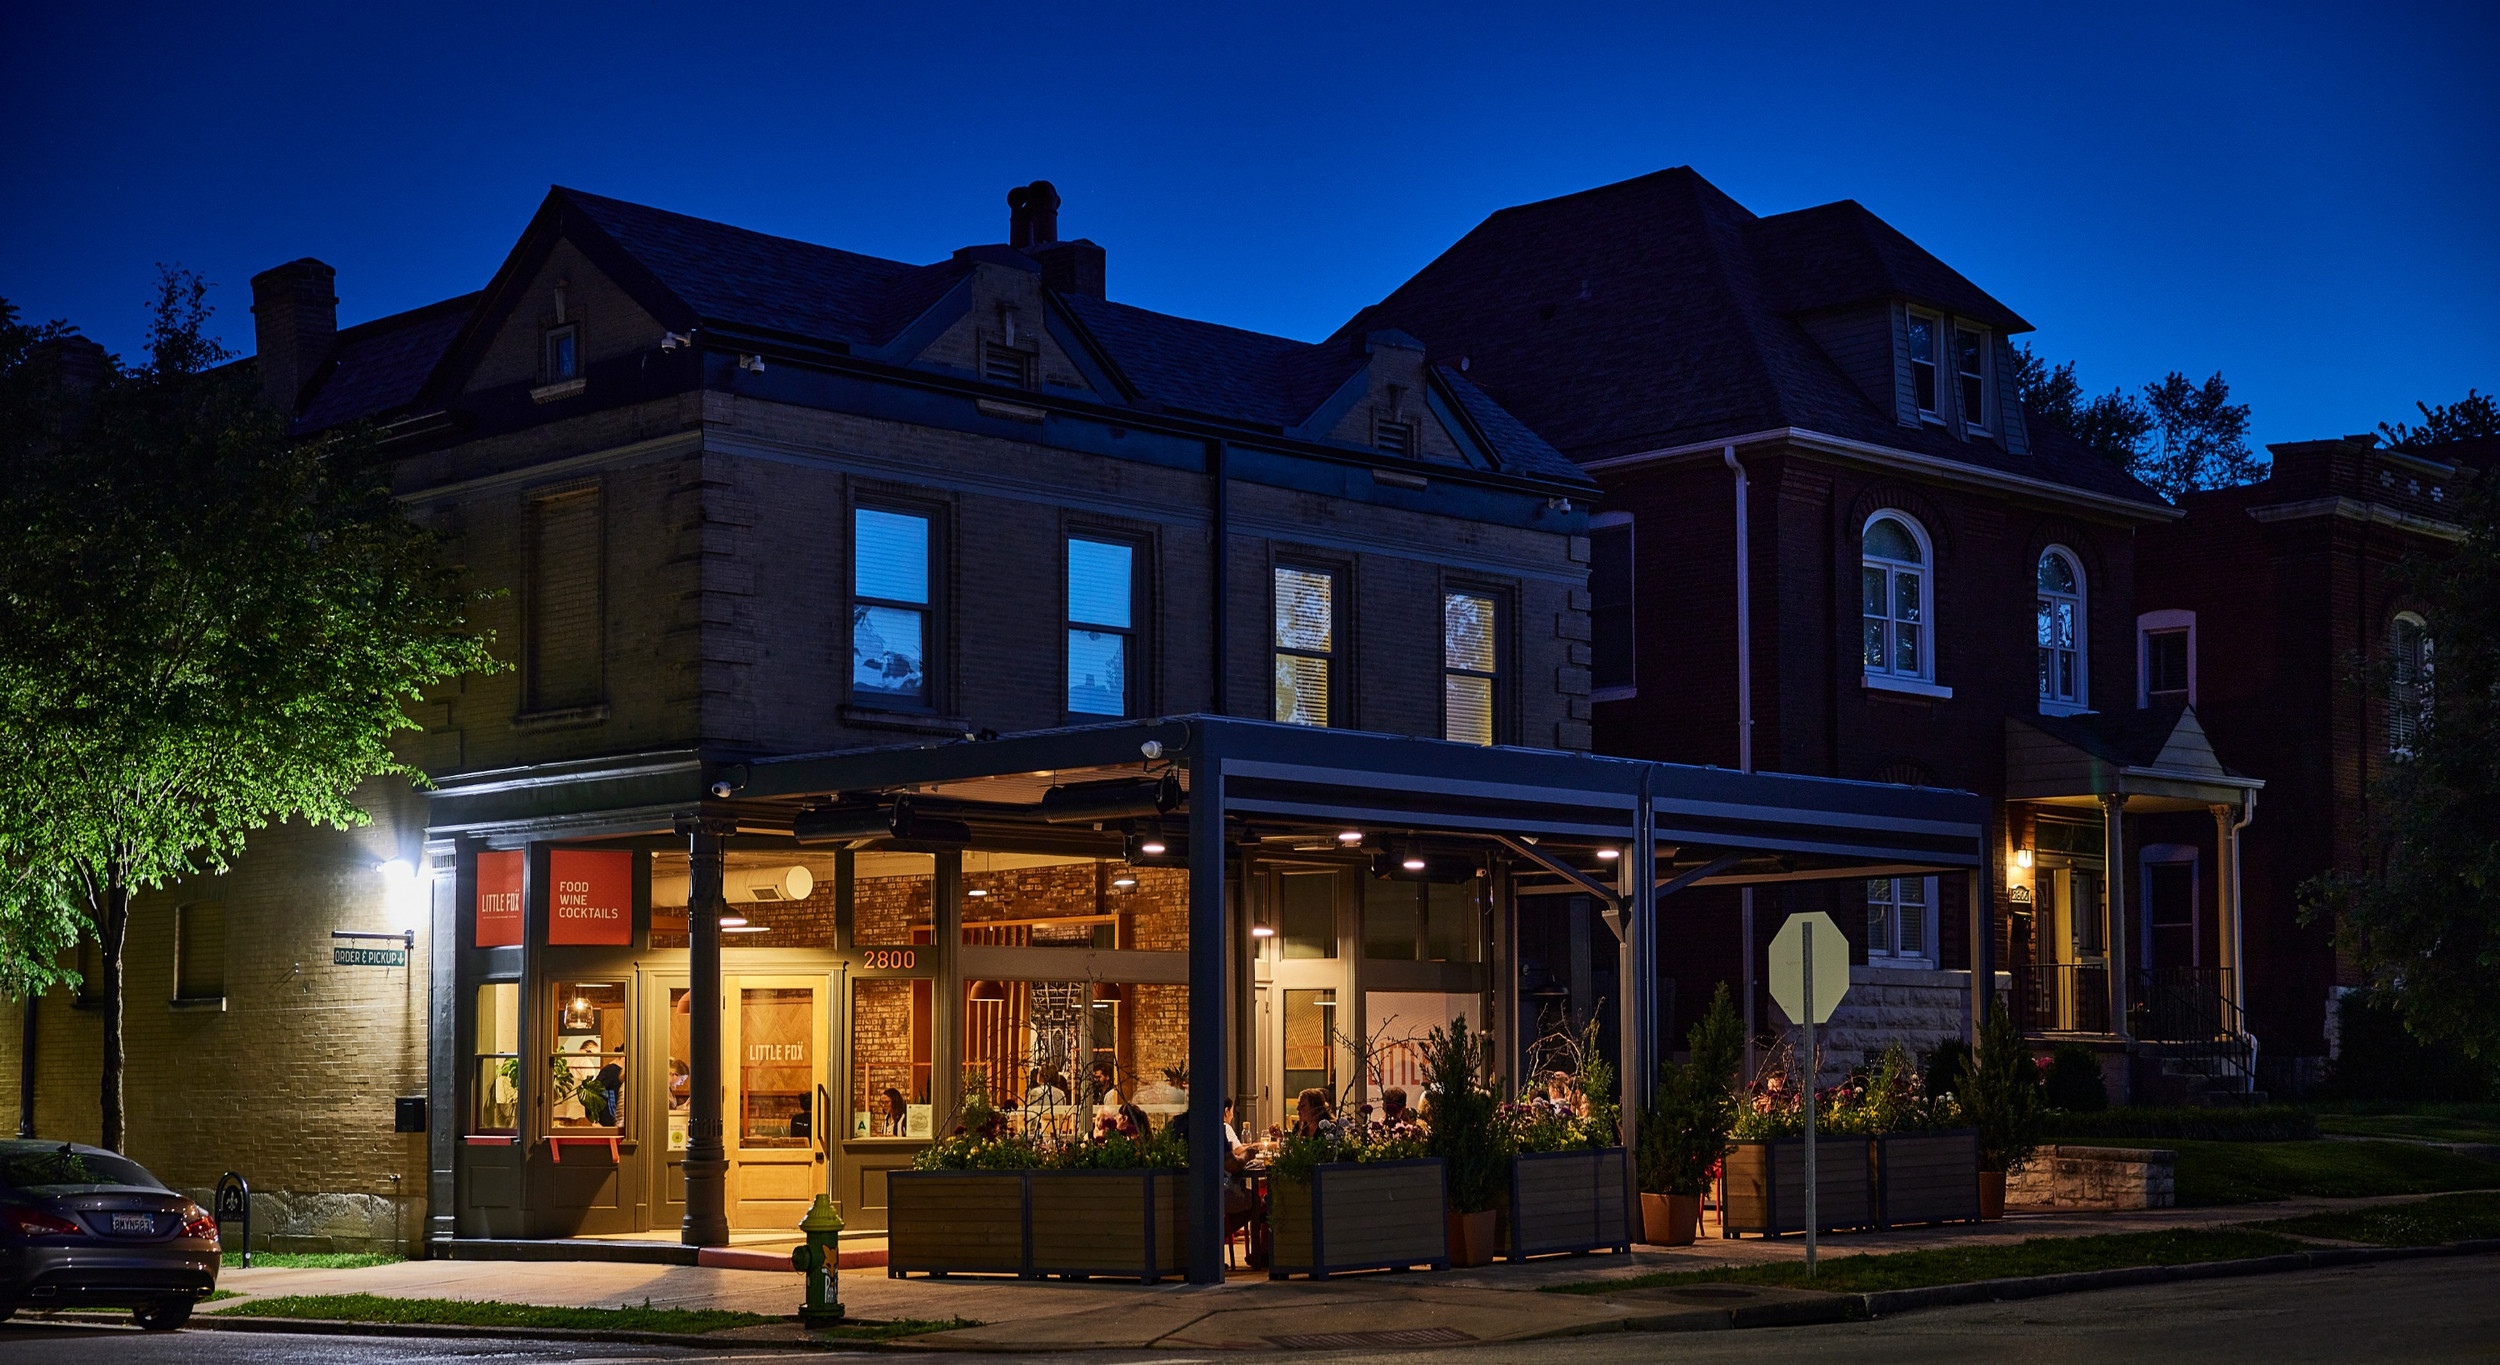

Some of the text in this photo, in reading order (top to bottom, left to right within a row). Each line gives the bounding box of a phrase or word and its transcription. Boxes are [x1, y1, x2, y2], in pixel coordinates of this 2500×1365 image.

[560, 881, 589, 892] FOOD
[482, 894, 505, 912] LITTLE
[560, 894, 587, 905] WINE
[559, 907, 619, 919] COCKTAILS
[335, 950, 360, 963] ORDER
[368, 951, 397, 964] PICKUP
[863, 950, 915, 969] 2800
[750, 1044, 782, 1061] LITTLE
[857, 1121, 866, 1130] A
